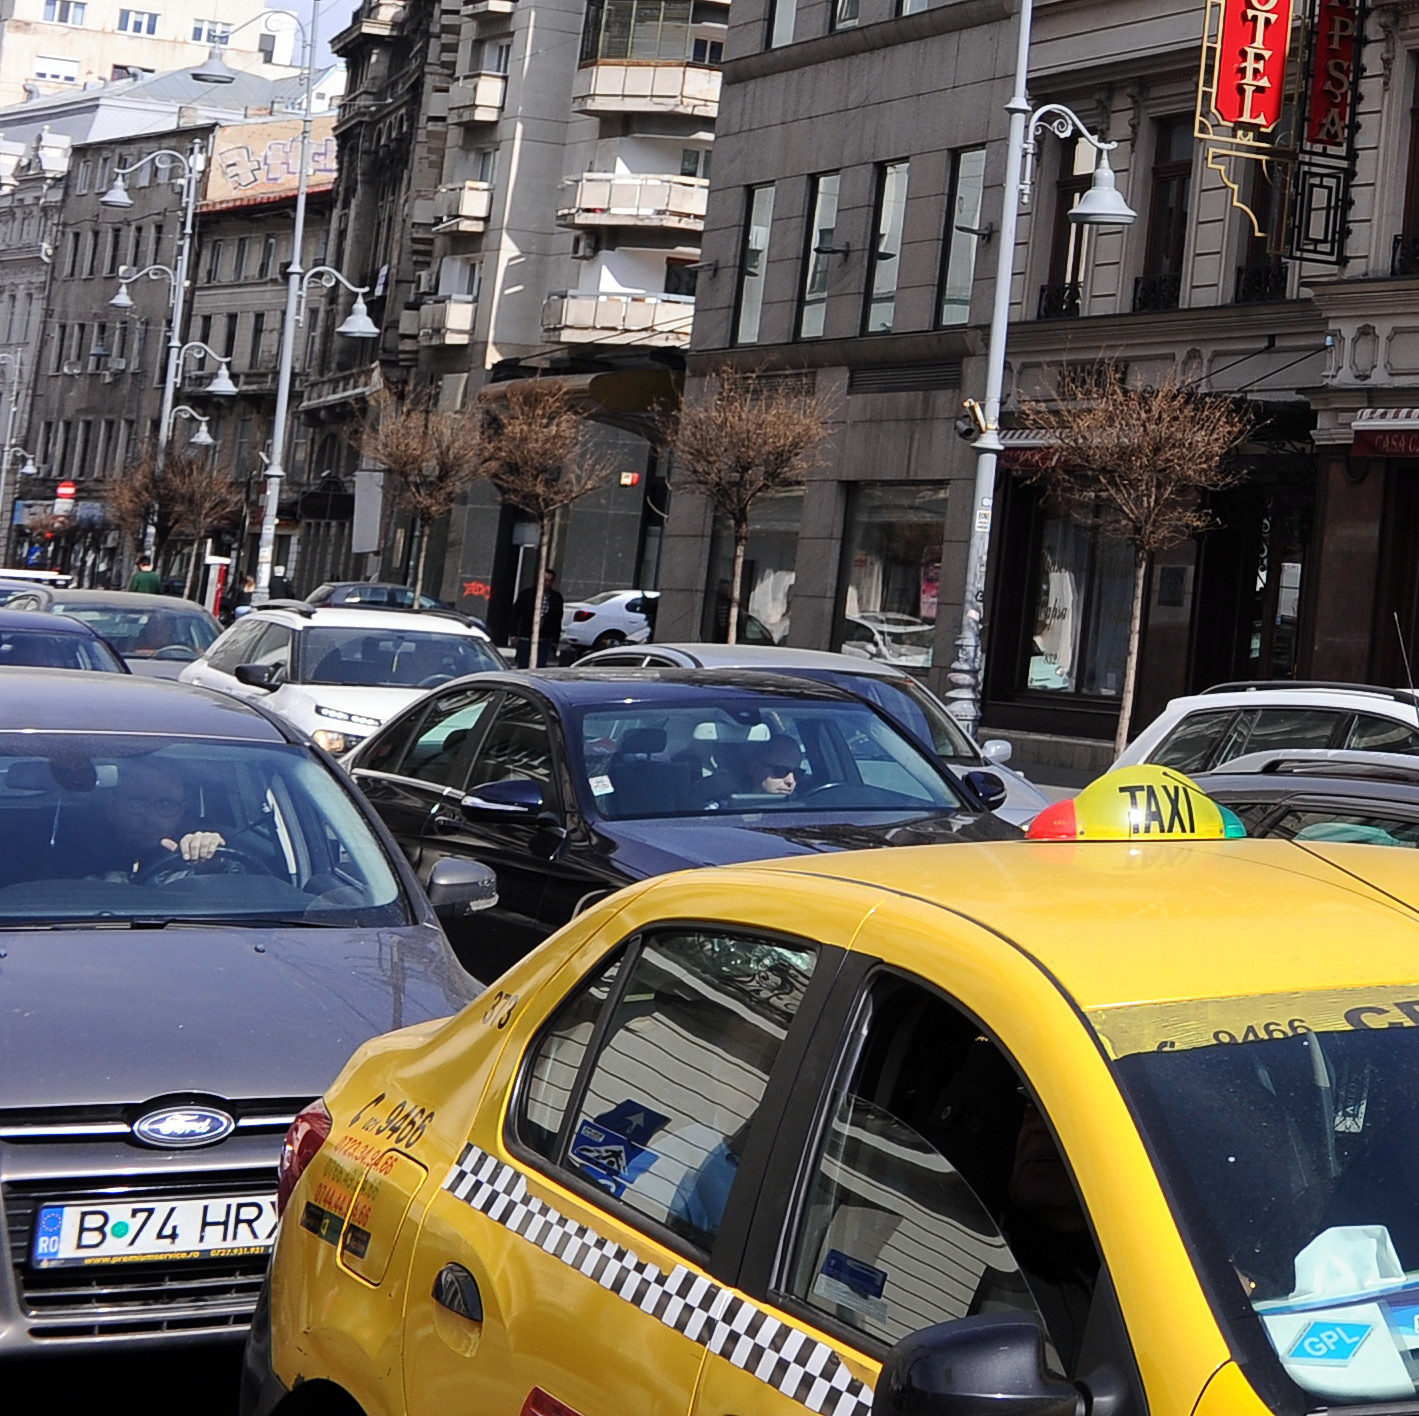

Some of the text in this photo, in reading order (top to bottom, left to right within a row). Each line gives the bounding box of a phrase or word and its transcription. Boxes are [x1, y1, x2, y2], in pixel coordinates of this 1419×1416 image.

[1375, 434, 1405, 453] CASA
[1118, 785, 1195, 834] TAXI
[375, 1100, 435, 1149] 9466
[38, 1235, 59, 1254] RO
[76, 1210, 110, 1250] B
[128, 1206, 180, 1247] 74
[1304, 1327, 1360, 1357] GPL
